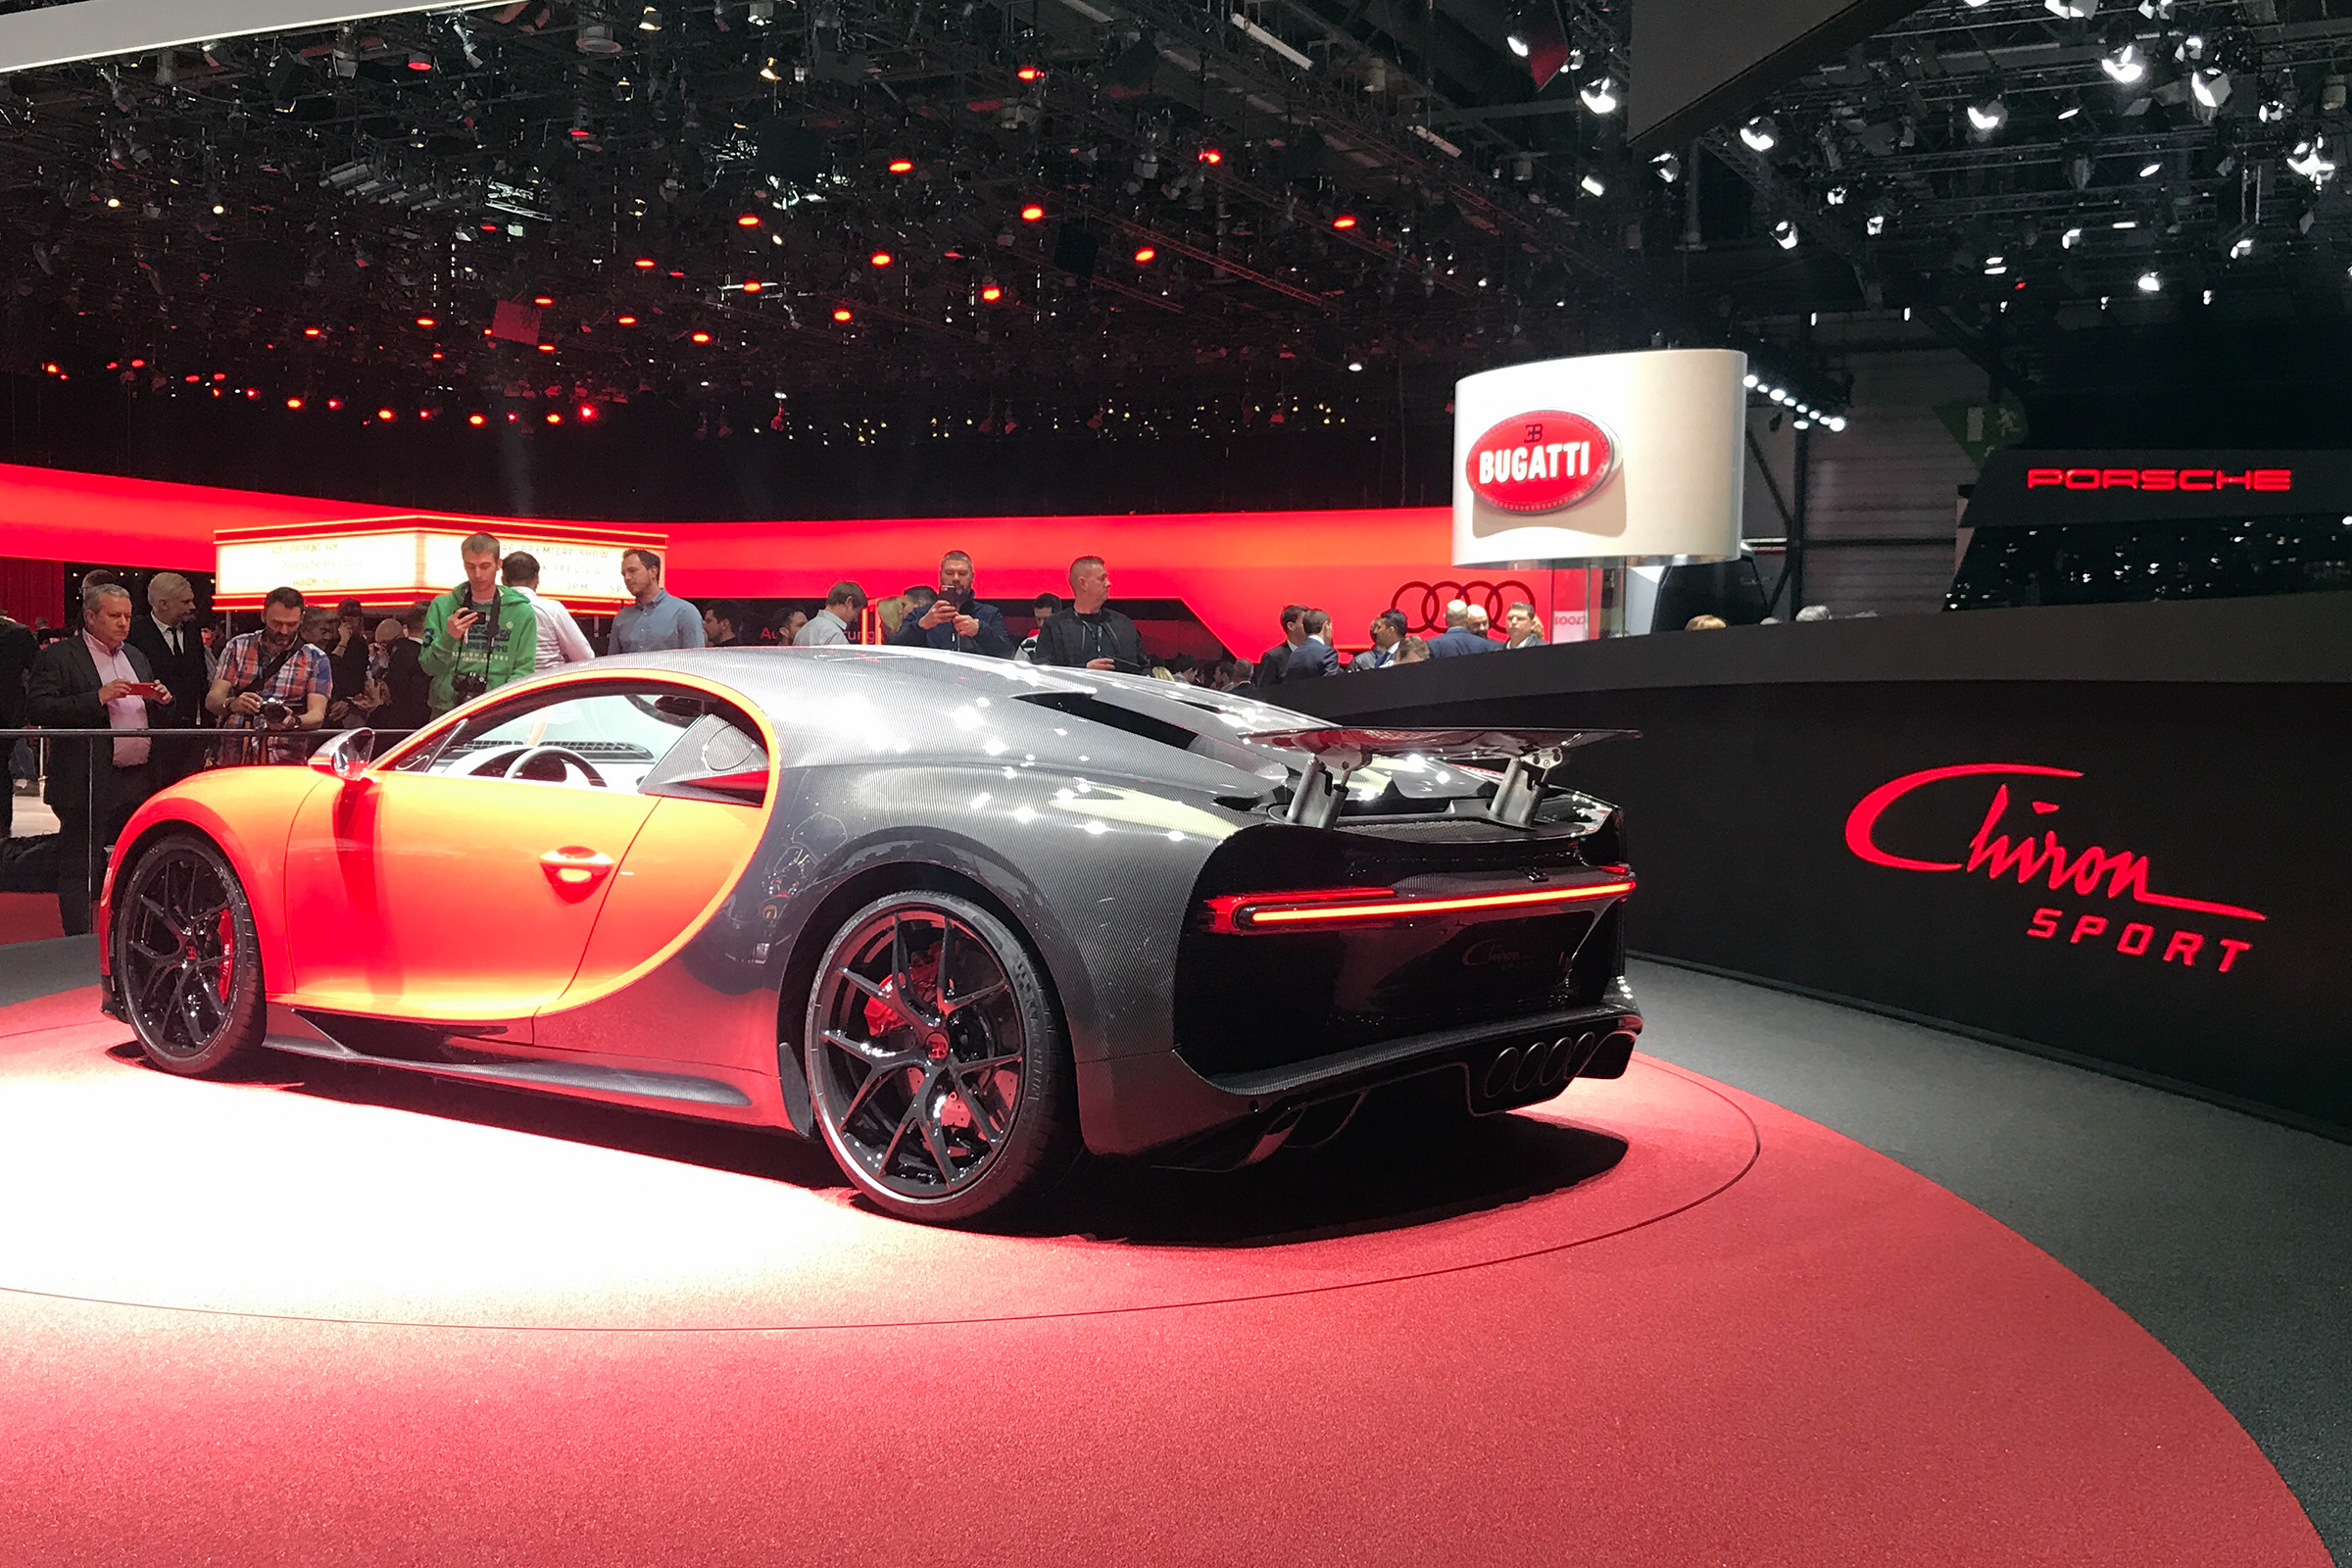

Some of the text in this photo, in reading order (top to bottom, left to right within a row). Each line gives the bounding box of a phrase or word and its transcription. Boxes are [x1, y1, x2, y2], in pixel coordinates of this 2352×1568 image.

[1479, 441, 1590, 484] BUGATTI
[2027, 467, 2292, 492] PORSCHE
[1844, 762, 2267, 921] Chiron
[2027, 906, 2253, 973] SPORT
